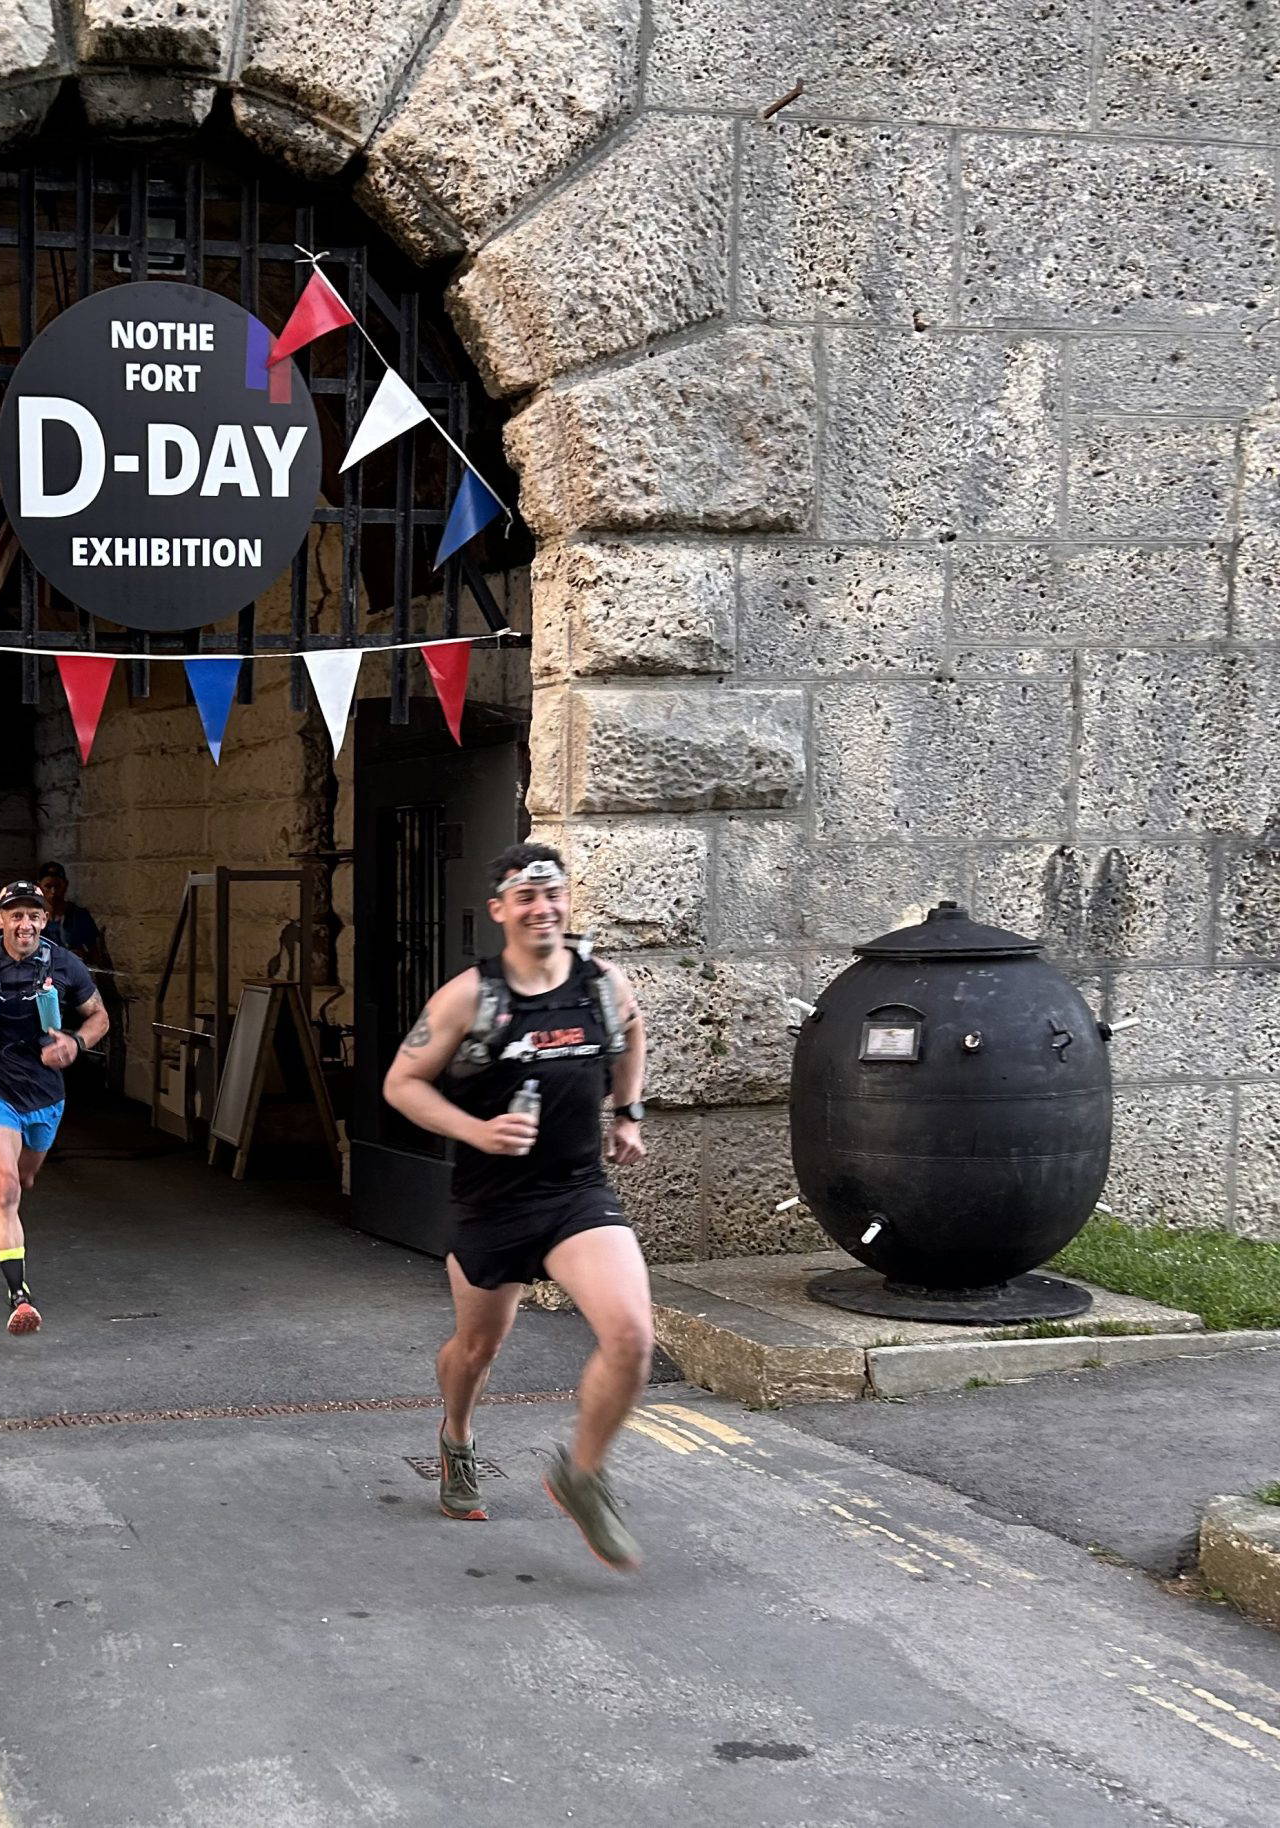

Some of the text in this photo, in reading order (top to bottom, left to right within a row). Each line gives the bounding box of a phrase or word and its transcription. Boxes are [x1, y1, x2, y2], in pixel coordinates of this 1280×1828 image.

[111, 320, 214, 351] NOTHE
[125, 363, 202, 392] FORT
[18, 396, 308, 518] D-DAY
[72, 537, 262, 567] EXHIBITION
